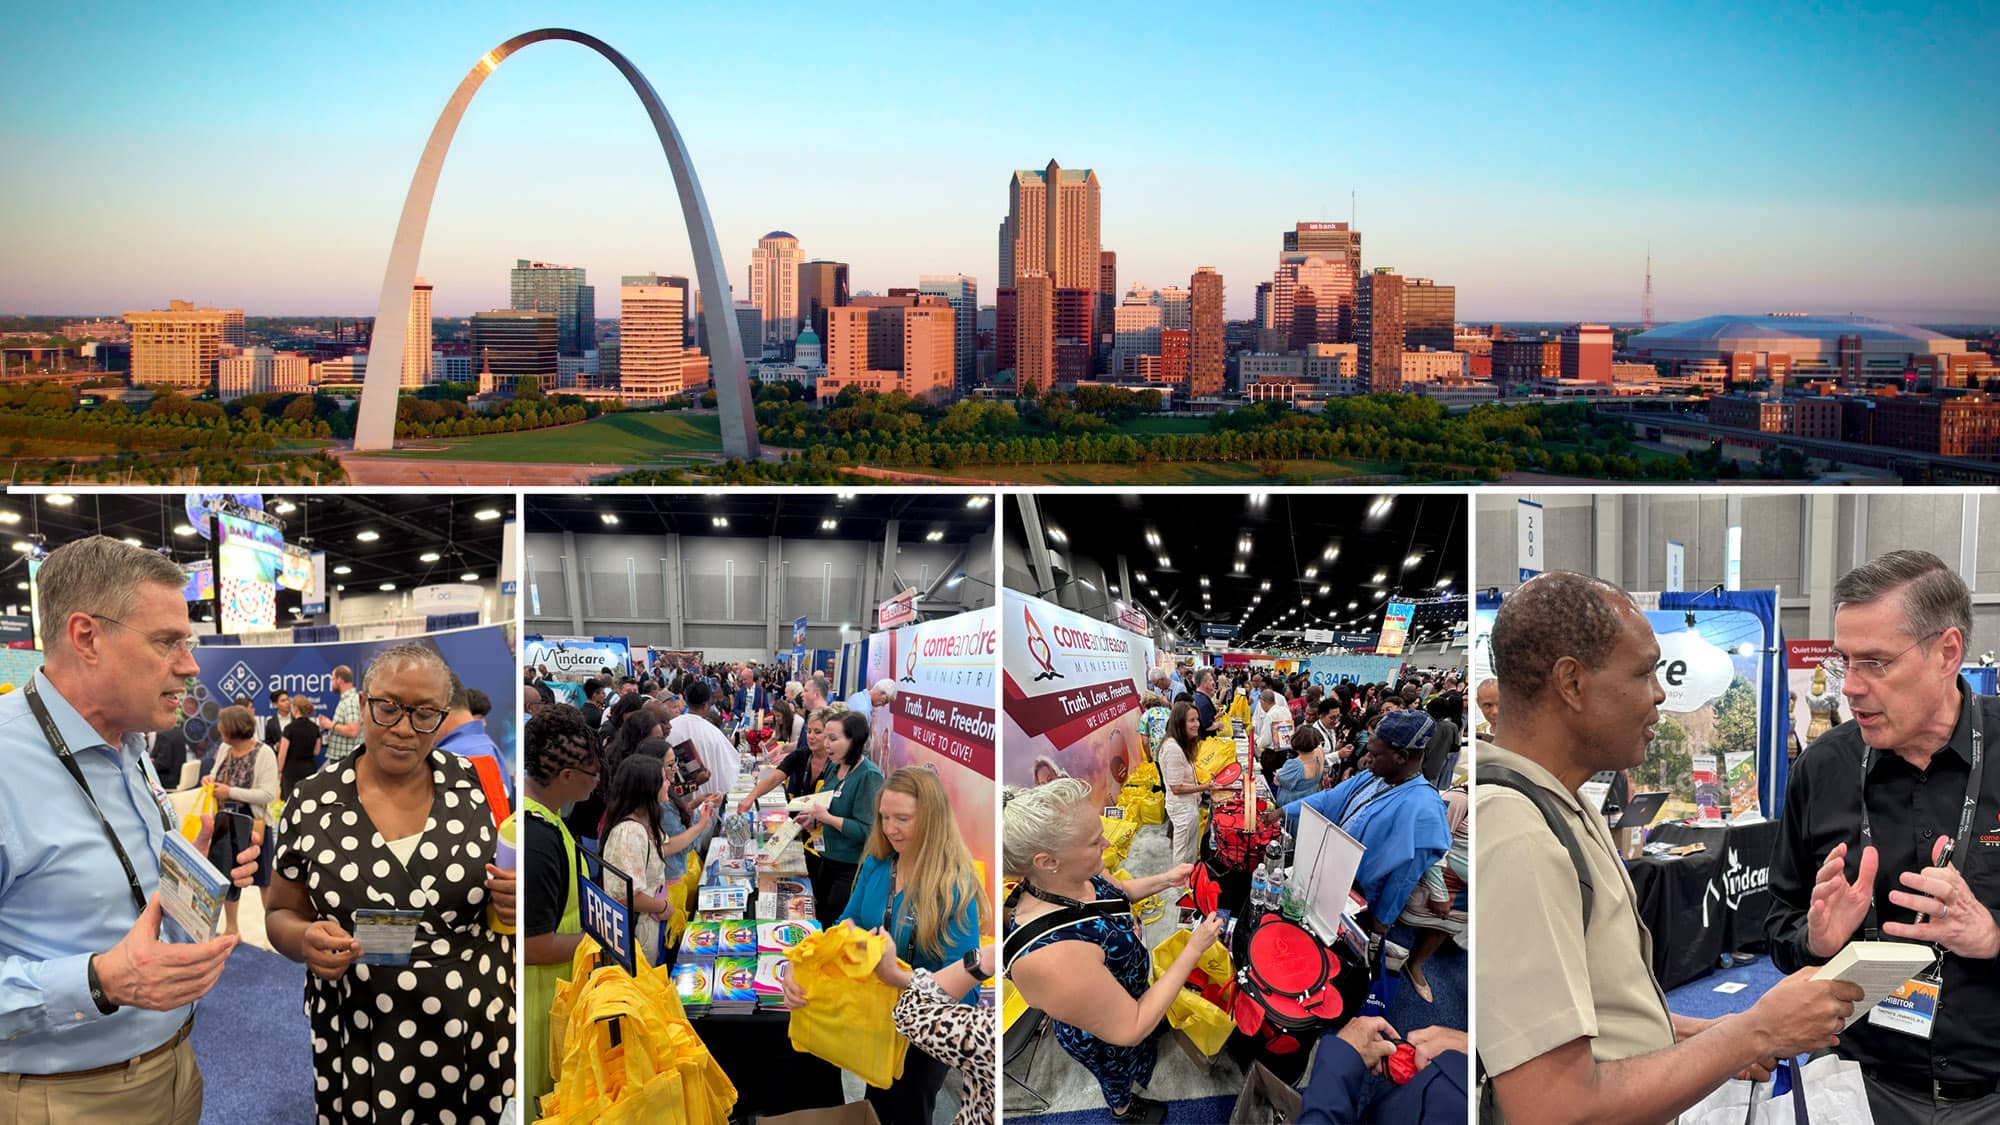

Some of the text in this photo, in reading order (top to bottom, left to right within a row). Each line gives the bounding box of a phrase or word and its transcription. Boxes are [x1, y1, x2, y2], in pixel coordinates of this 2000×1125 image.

[532, 648, 605, 671] Mindcare
[1791, 646, 1810, 654] Quiet
[1811, 646, 1827, 654] Hour
[904, 697, 923, 718] Truth.
[926, 700, 947, 726] Love.
[1058, 692, 1091, 716] Truth.
[1090, 690, 1110, 706] Love.
[1086, 715, 1098, 729] WE
[1098, 710, 1110, 724] LIVE
[912, 726, 973, 763] WE LIVE TO GIVE!
[586, 886, 625, 957] FREE
